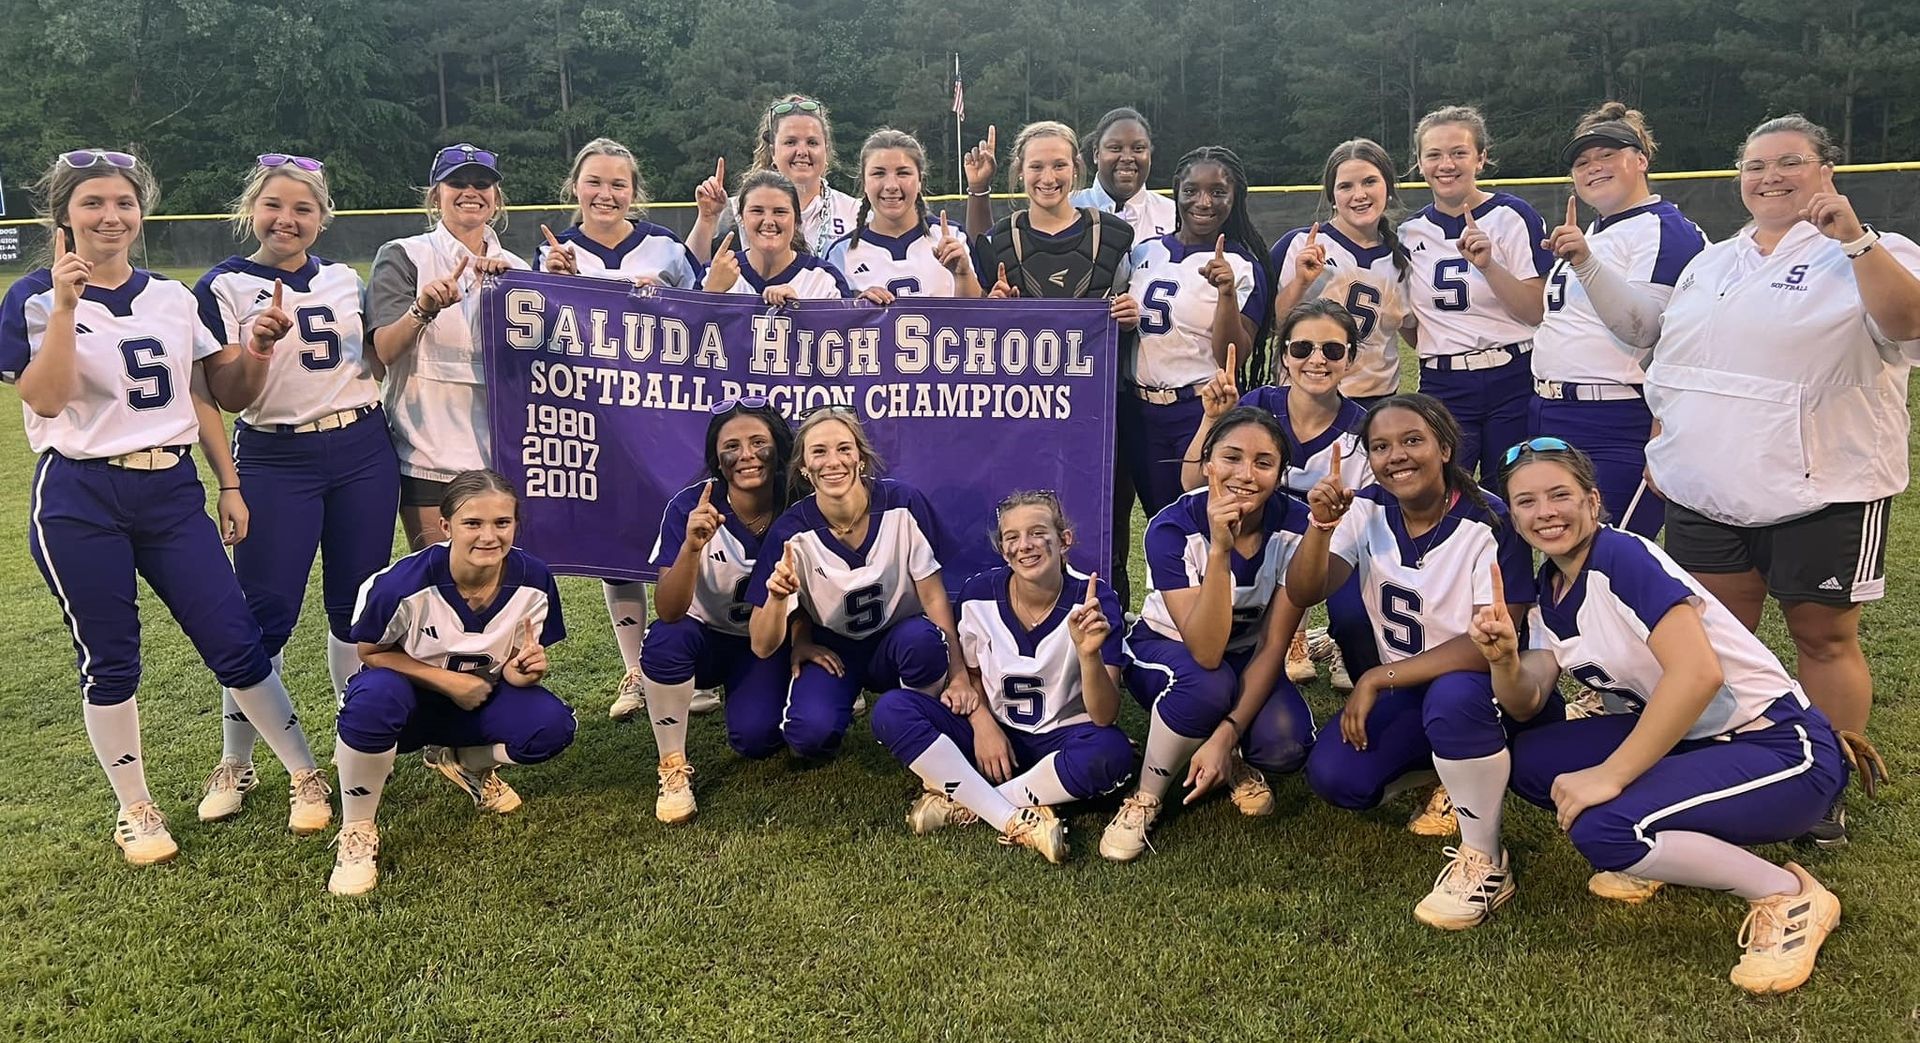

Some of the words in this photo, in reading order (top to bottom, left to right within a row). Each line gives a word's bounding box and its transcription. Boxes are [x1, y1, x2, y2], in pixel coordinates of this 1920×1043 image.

[833, 218, 845, 235] S
[1431, 257, 1471, 312] S
[1770, 282, 1808, 292] SOFTBALL
[1785, 264, 1809, 284] S
[505, 288, 729, 371] SALUDA
[750, 314, 881, 378] HIGH
[894, 314, 1094, 377] SCHOOL
[1137, 278, 1181, 335] S
[1345, 280, 1381, 342] S
[295, 304, 344, 373] S
[118, 335, 175, 412] S
[530, 359, 713, 412] SOFTBALL
[865, 382, 1071, 421] CHAMPIONS
[525, 403, 597, 442] 1980
[522, 435, 600, 472] 2007
[525, 466, 598, 502] 2010
[843, 582, 887, 634] S
[1379, 580, 1426, 657] S
[1000, 673, 1047, 728] S
